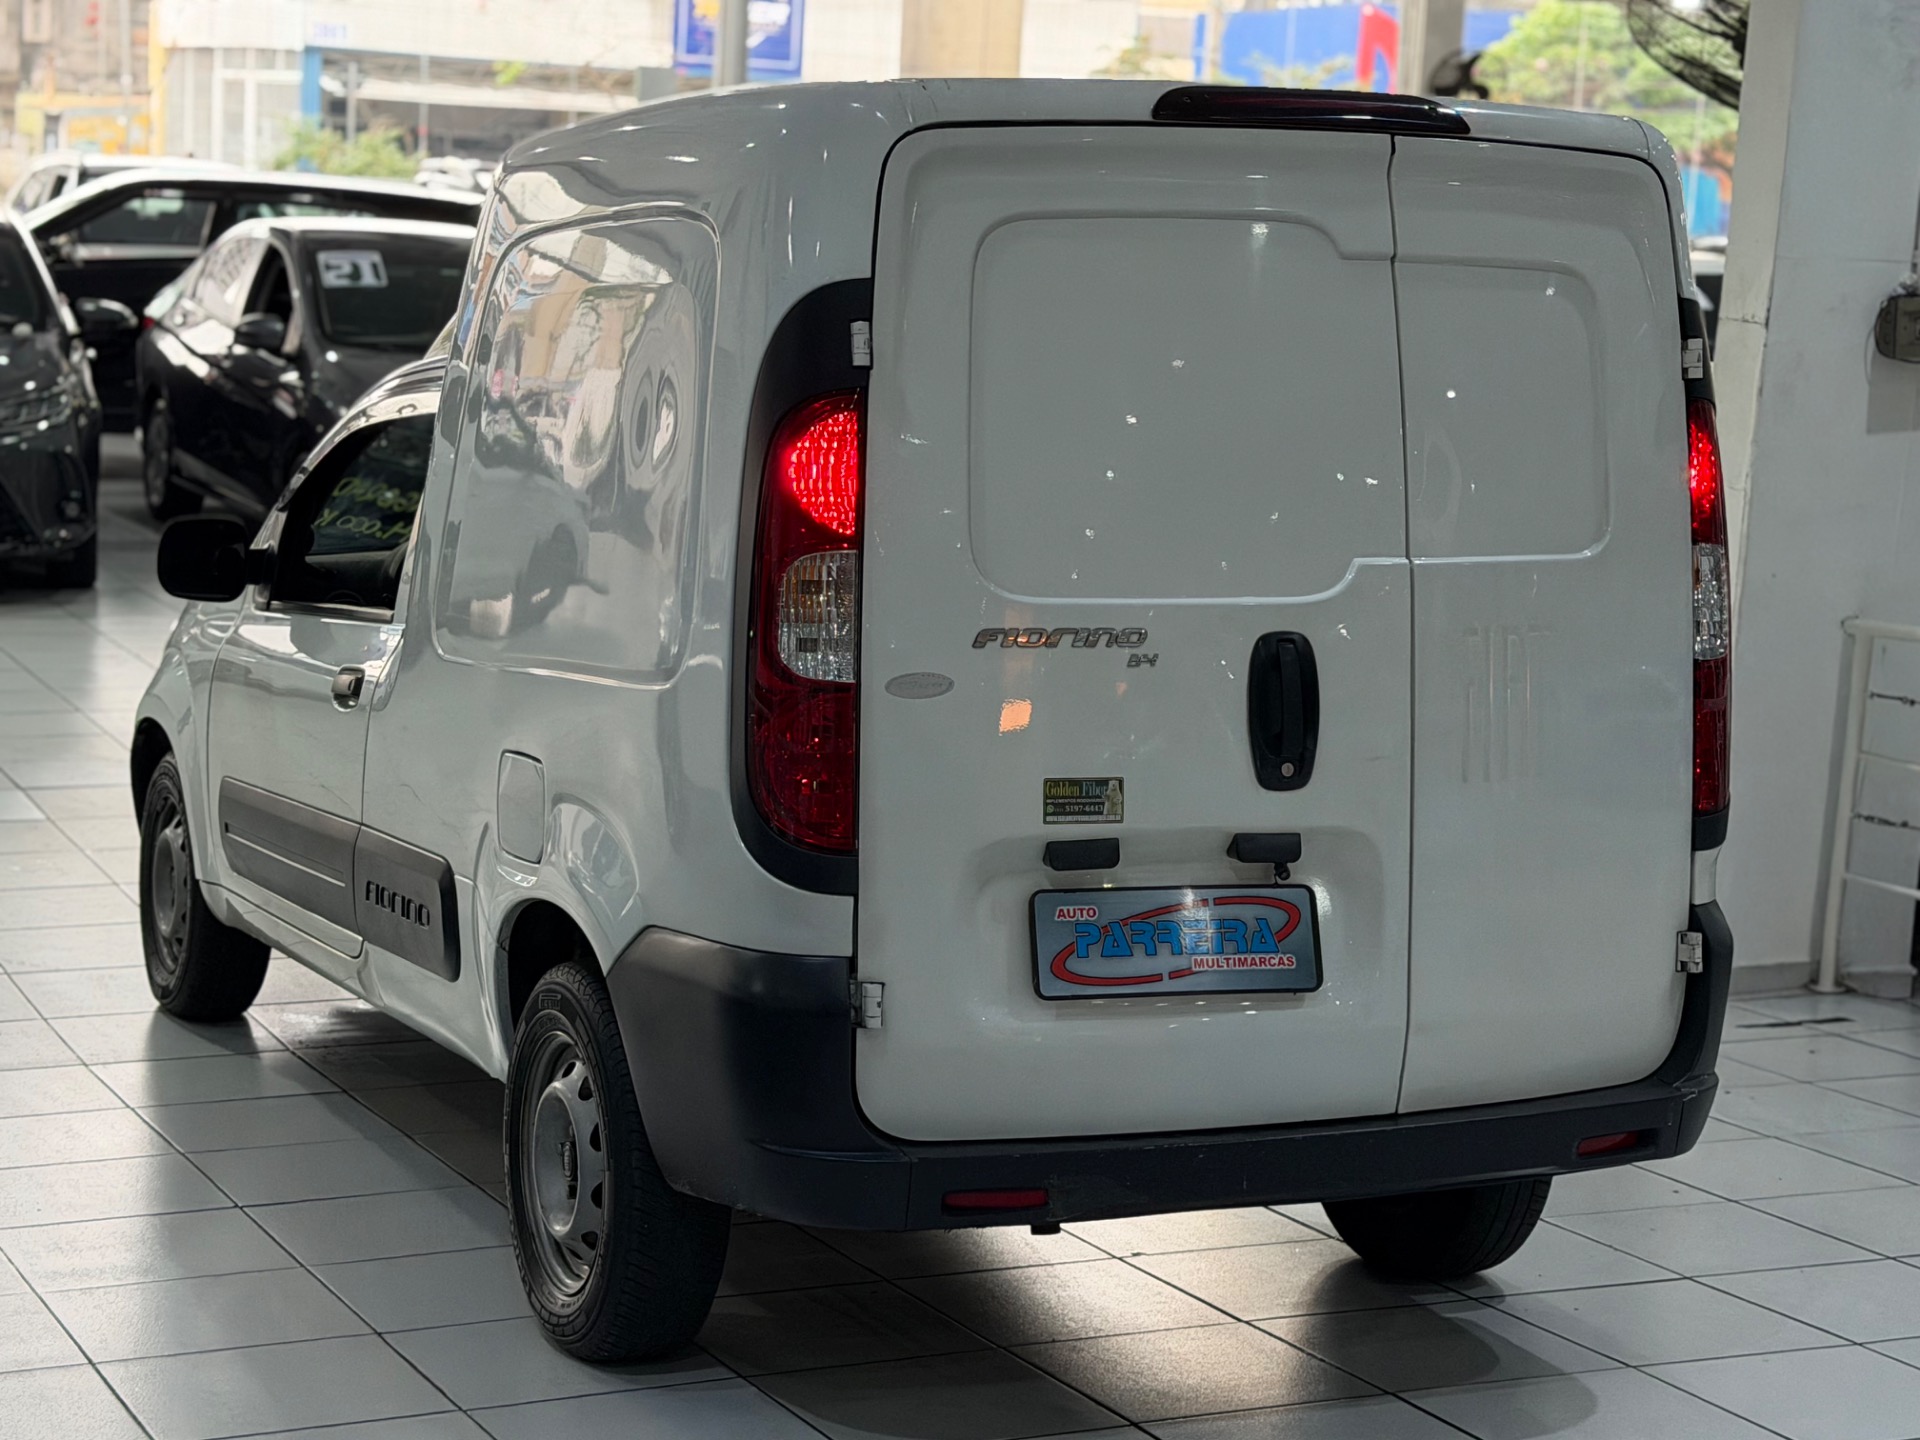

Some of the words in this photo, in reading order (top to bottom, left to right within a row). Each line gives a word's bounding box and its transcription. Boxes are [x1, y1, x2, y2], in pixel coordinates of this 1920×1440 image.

[1046, 782, 1080, 796] Golden
[1056, 906, 1097, 920] AUTO
[1074, 917, 1280, 959] PARREIRA
[1193, 955, 1295, 970] MULTIMARCAS
